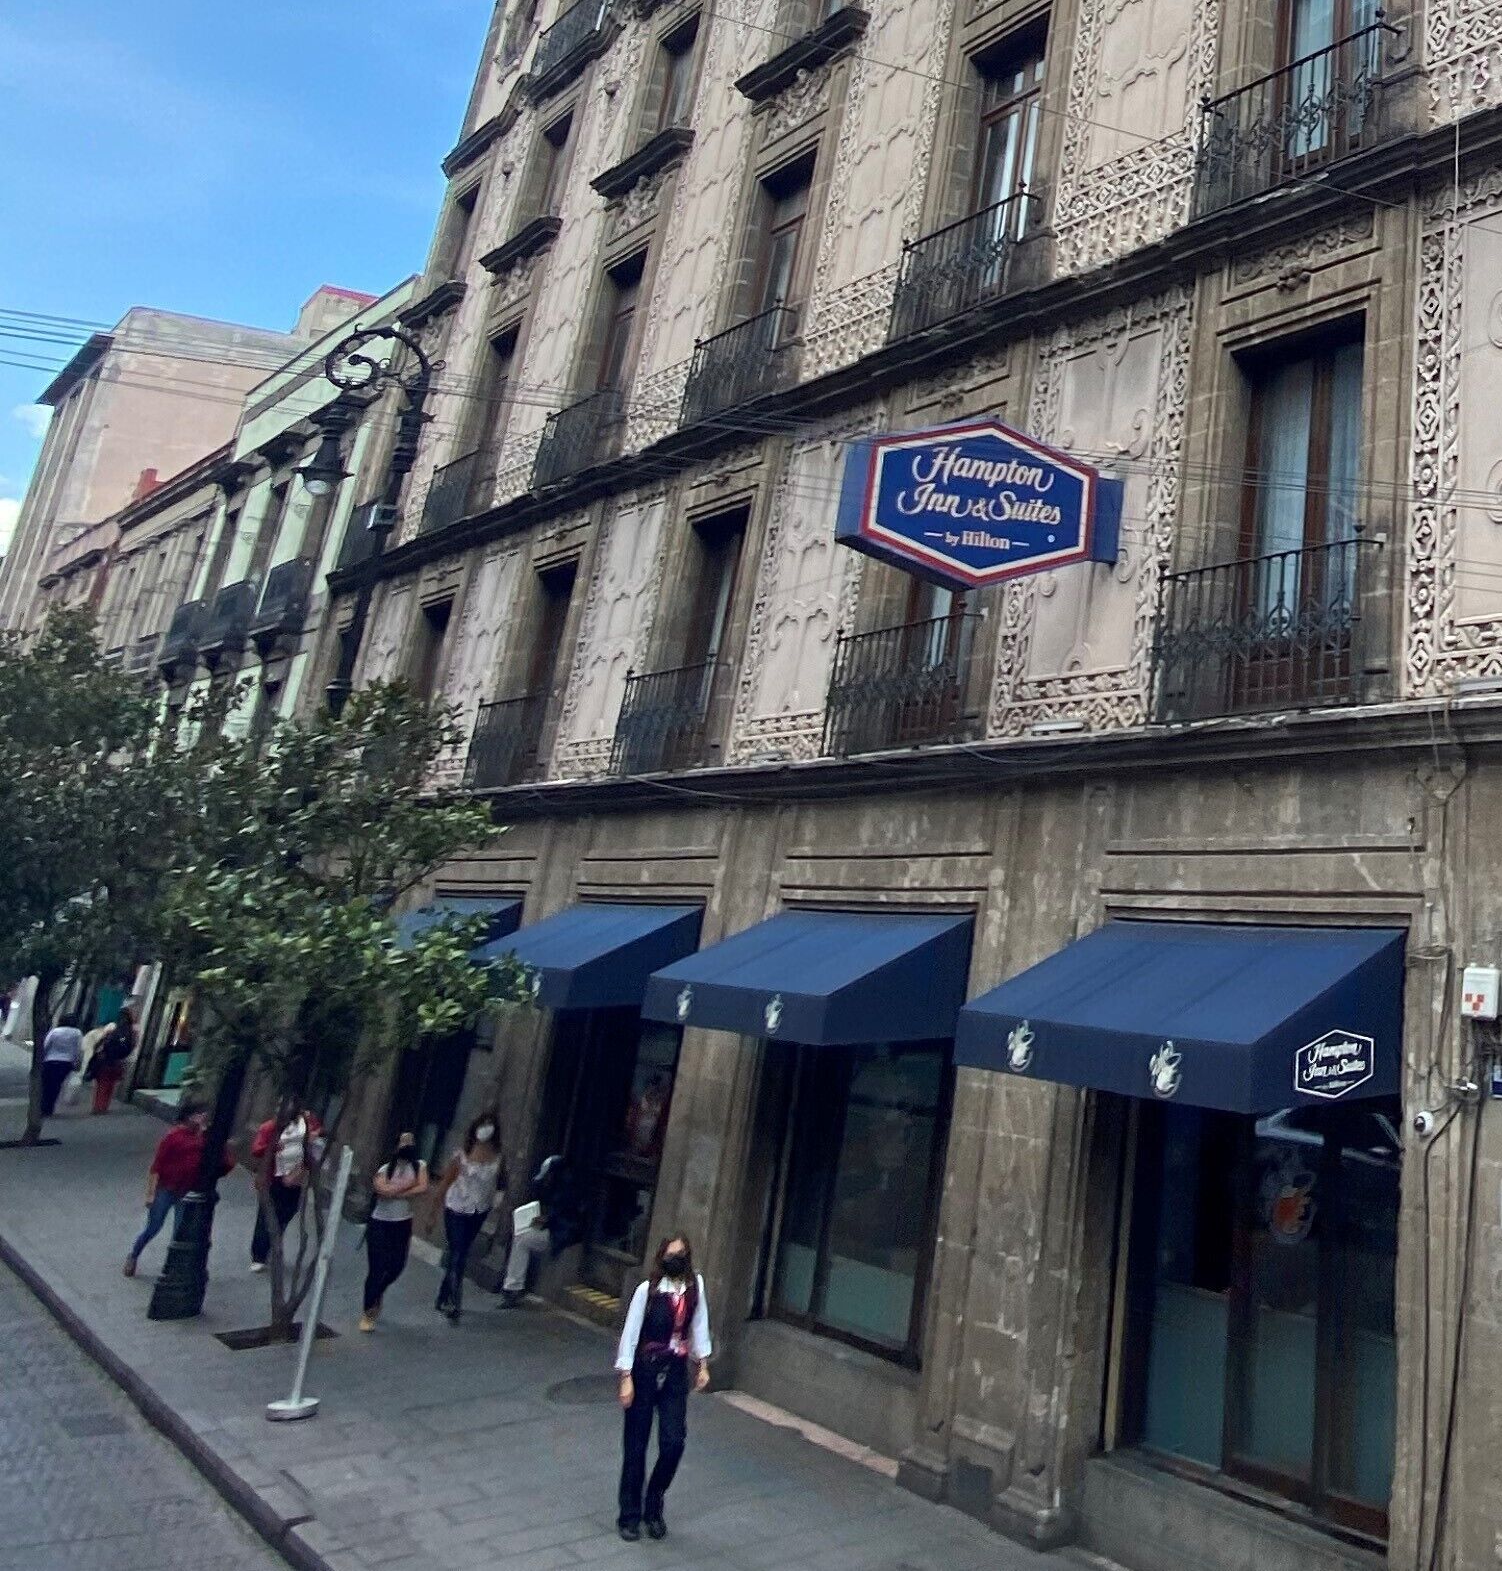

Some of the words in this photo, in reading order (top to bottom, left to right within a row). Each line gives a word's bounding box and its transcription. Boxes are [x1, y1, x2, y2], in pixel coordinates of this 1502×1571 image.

[912, 445, 1054, 493] Hampton
[898, 483, 974, 518] Inn
[974, 499, 991, 522] &
[988, 490, 1062, 526] Suites
[944, 531, 960, 547] by
[961, 530, 1011, 550] Hilton
[1308, 1041, 1362, 1063] Hampton
